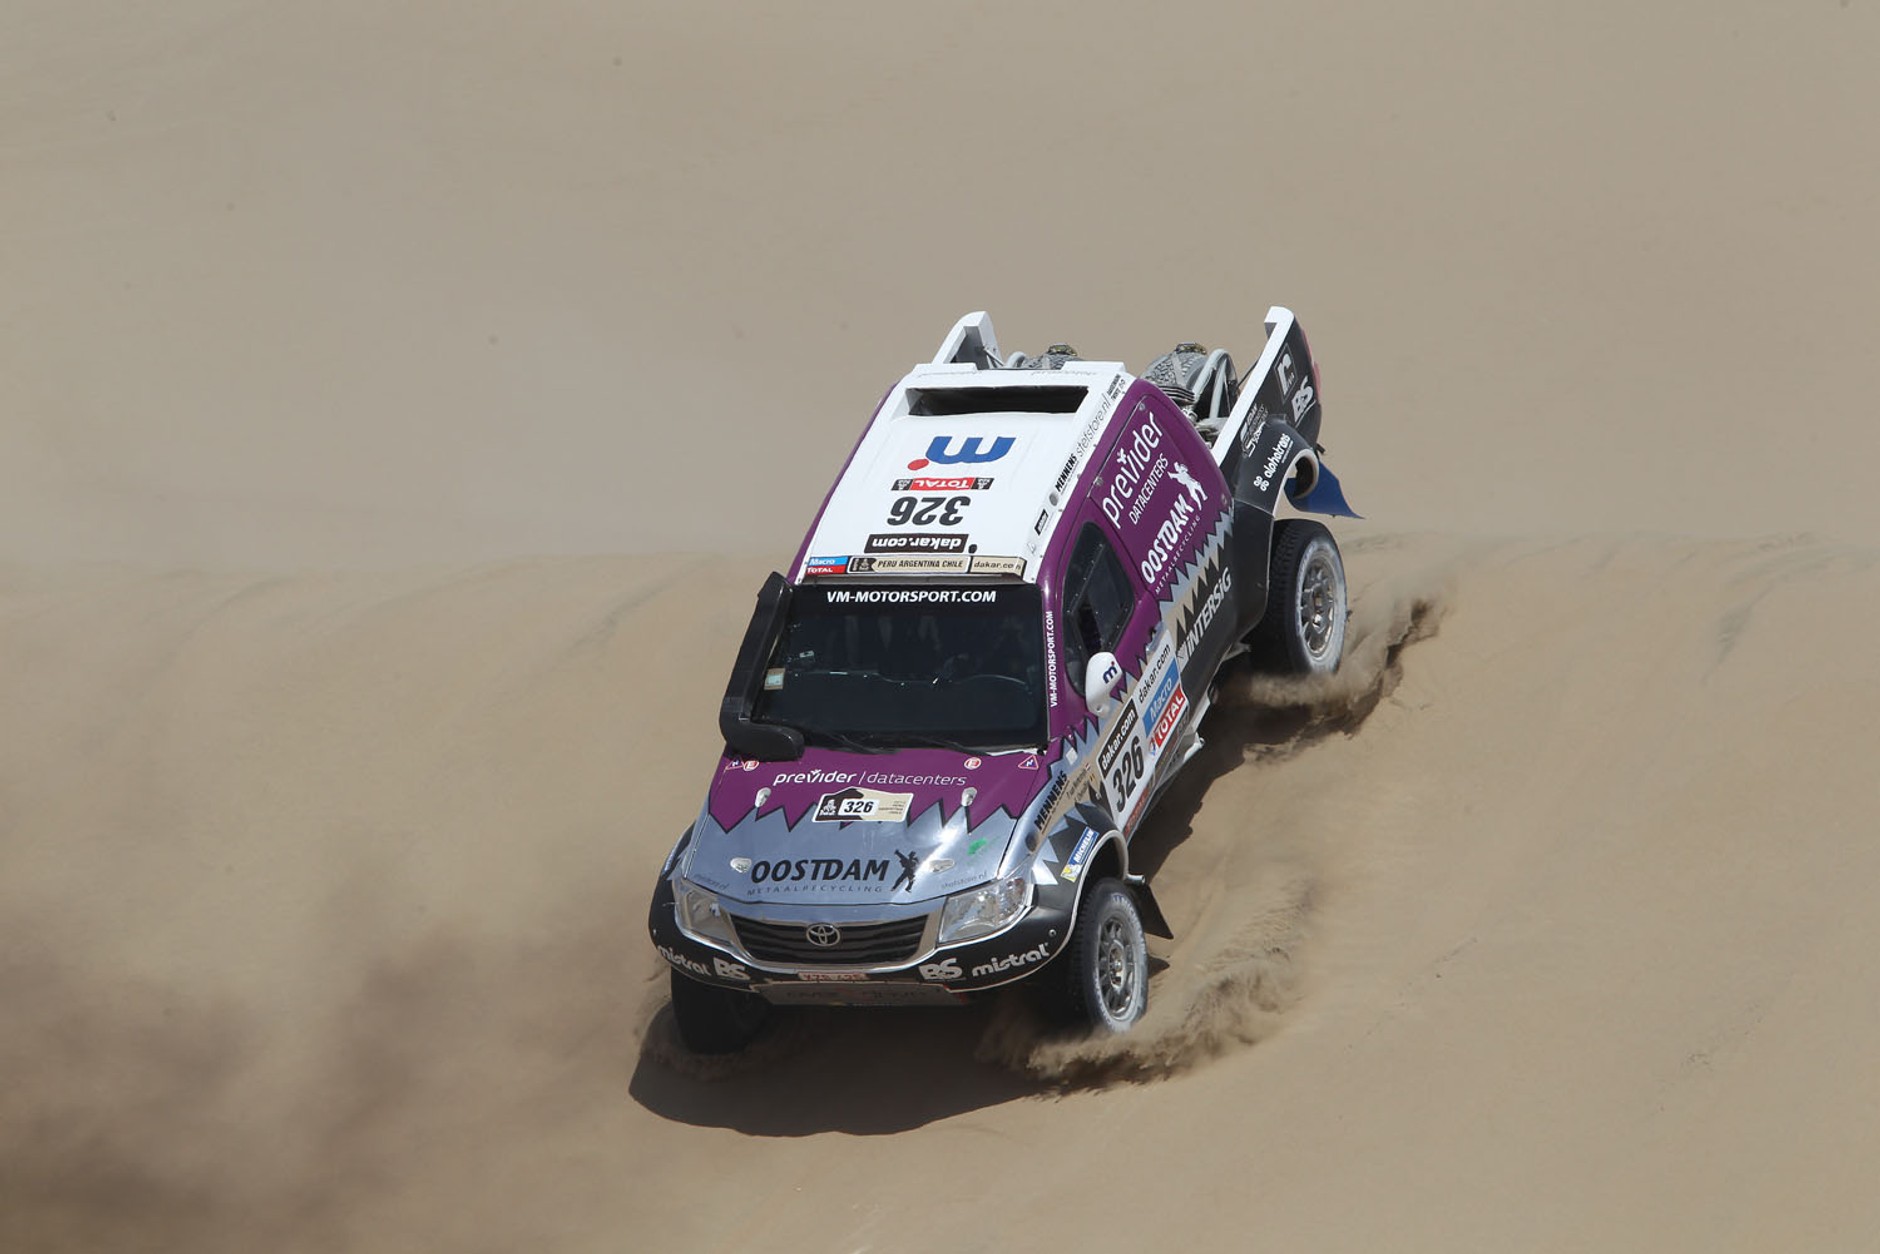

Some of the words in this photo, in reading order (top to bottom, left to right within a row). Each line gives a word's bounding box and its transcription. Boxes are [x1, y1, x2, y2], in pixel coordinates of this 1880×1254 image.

[913, 480, 970, 489] TOTAL
[1054, 452, 1077, 492] MENNENS
[1102, 412, 1163, 529] previder
[1128, 452, 1169, 525] DATACENTERS
[887, 496, 970, 526] 326
[872, 537, 962, 550] dakar.com
[1141, 493, 1194, 584] OOSTDAM
[808, 566, 833, 574] TOTAL
[877, 559, 897, 569] PERU
[897, 559, 940, 569] ARGENTINA
[940, 559, 963, 568] CHILE
[826, 590, 997, 603] VM-MOTORSPORT.COM
[1047, 611, 1058, 708] VM-MOTORSPORT.COM
[1138, 644, 1171, 704] dakar.com
[1155, 693, 1187, 740] TOTAL
[1101, 709, 1137, 771] dakar.com
[773, 768, 858, 787] previder
[867, 771, 967, 787] datacenters
[1112, 736, 1145, 813] 326
[843, 800, 874, 814] 326
[1035, 770, 1068, 832] MENNENS
[751, 858, 889, 884] OOSTDAM
[657, 944, 712, 977] mistral
[971, 944, 1050, 978] mistral
